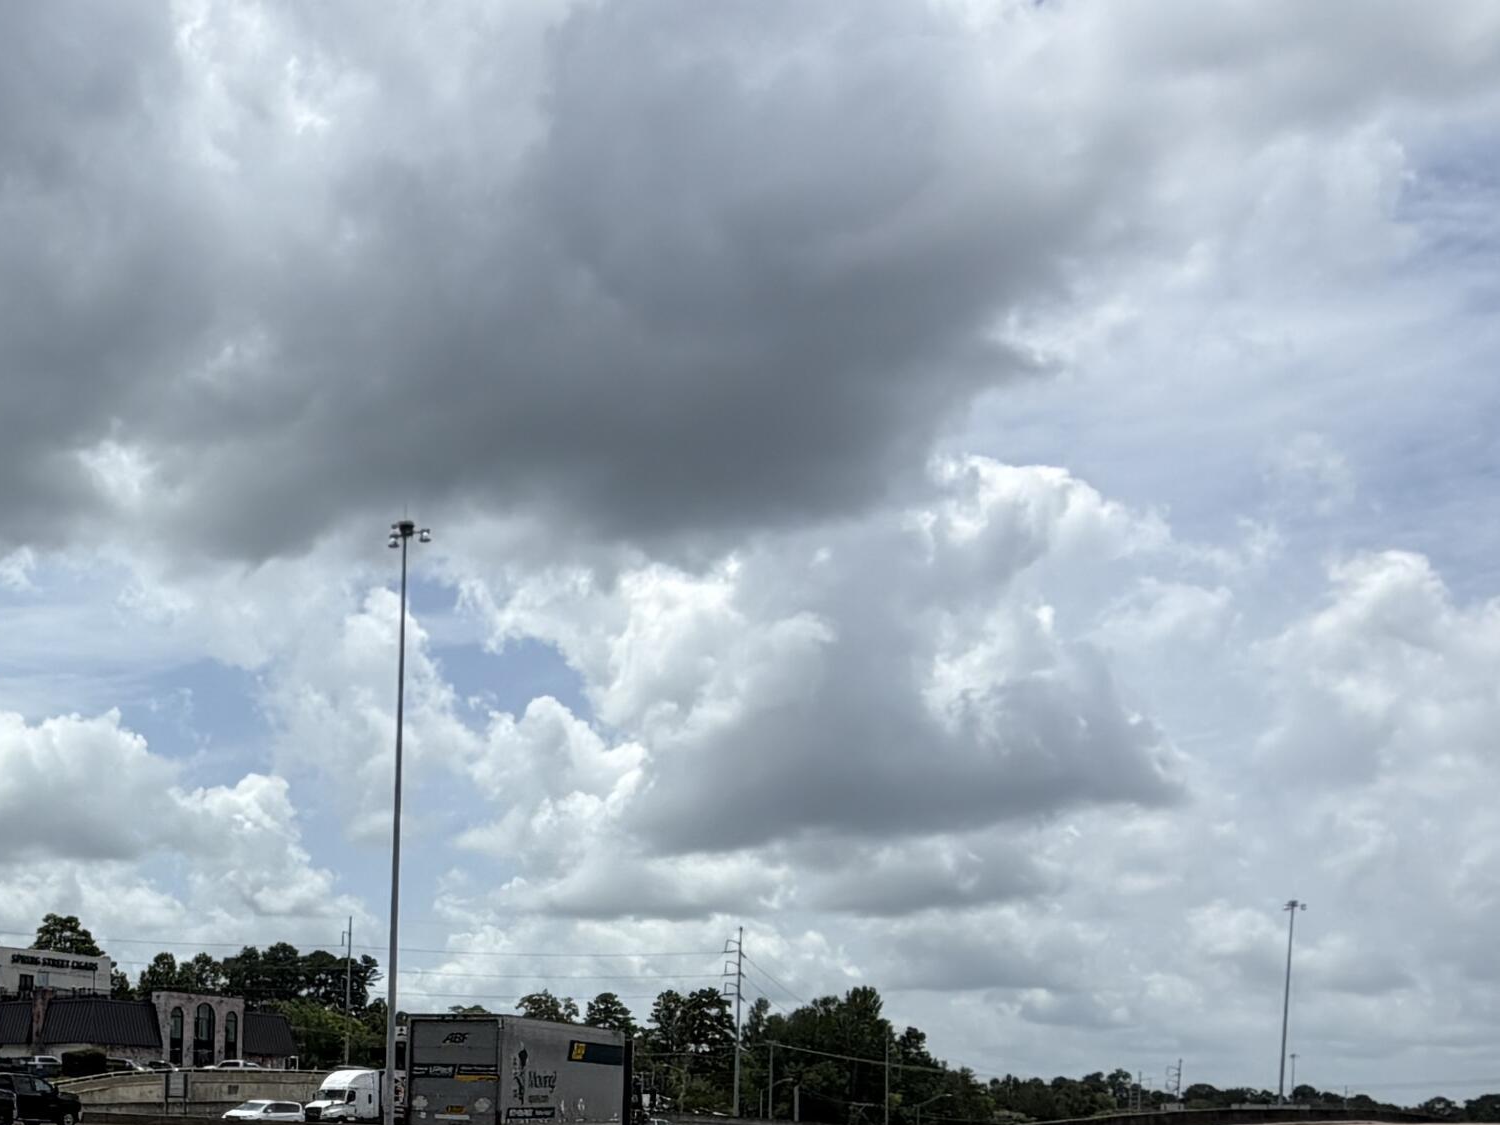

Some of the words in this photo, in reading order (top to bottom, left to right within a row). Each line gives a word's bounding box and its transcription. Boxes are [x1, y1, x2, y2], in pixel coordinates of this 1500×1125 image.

[11, 954, 40, 966] SPRING
[41, 957, 70, 969] STREET
[71, 960, 98, 971] CIGARS
[442, 1032, 469, 1044] ABF
